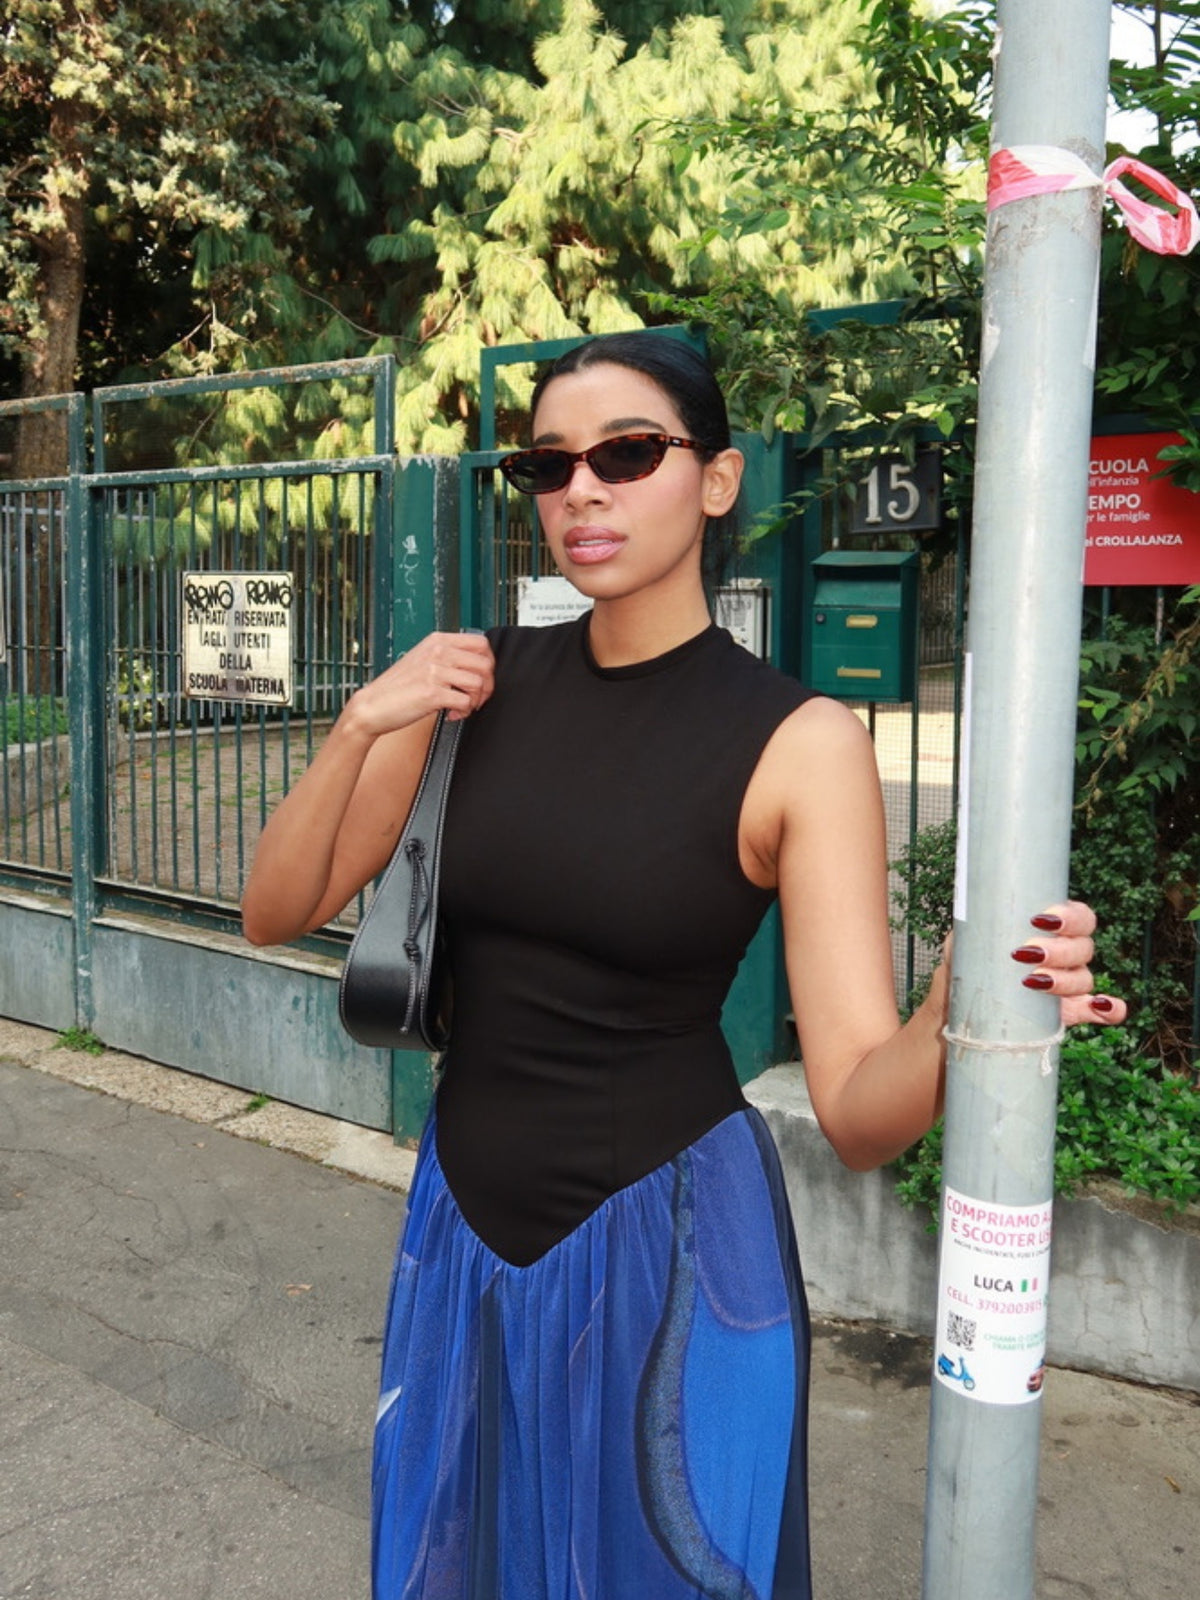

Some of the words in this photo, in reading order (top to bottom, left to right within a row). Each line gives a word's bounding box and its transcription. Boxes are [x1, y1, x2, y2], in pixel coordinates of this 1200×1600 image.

[1088, 457, 1150, 475] CUOLA
[1088, 475, 1140, 488] ll'infanzia
[859, 463, 920, 523] 15
[1088, 493, 1142, 510] EMPO
[1097, 511, 1107, 523] le
[1109, 510, 1151, 524] famiglie
[1095, 533, 1183, 547] CROLLALANZA
[188, 609, 227, 625] ENRAT
[235, 610, 287, 627] RISERVATA
[234, 632, 270, 649] UTENTI
[219, 652, 253, 671] DELLA
[189, 672, 228, 691] SCUOLA
[946, 1195, 1040, 1228] COMPRIAMO
[951, 1217, 959, 1233] E
[962, 1222, 1036, 1248] SCOOTER
[973, 1275, 1014, 1292] LUCA
[946, 1285, 974, 1307] CELL.
